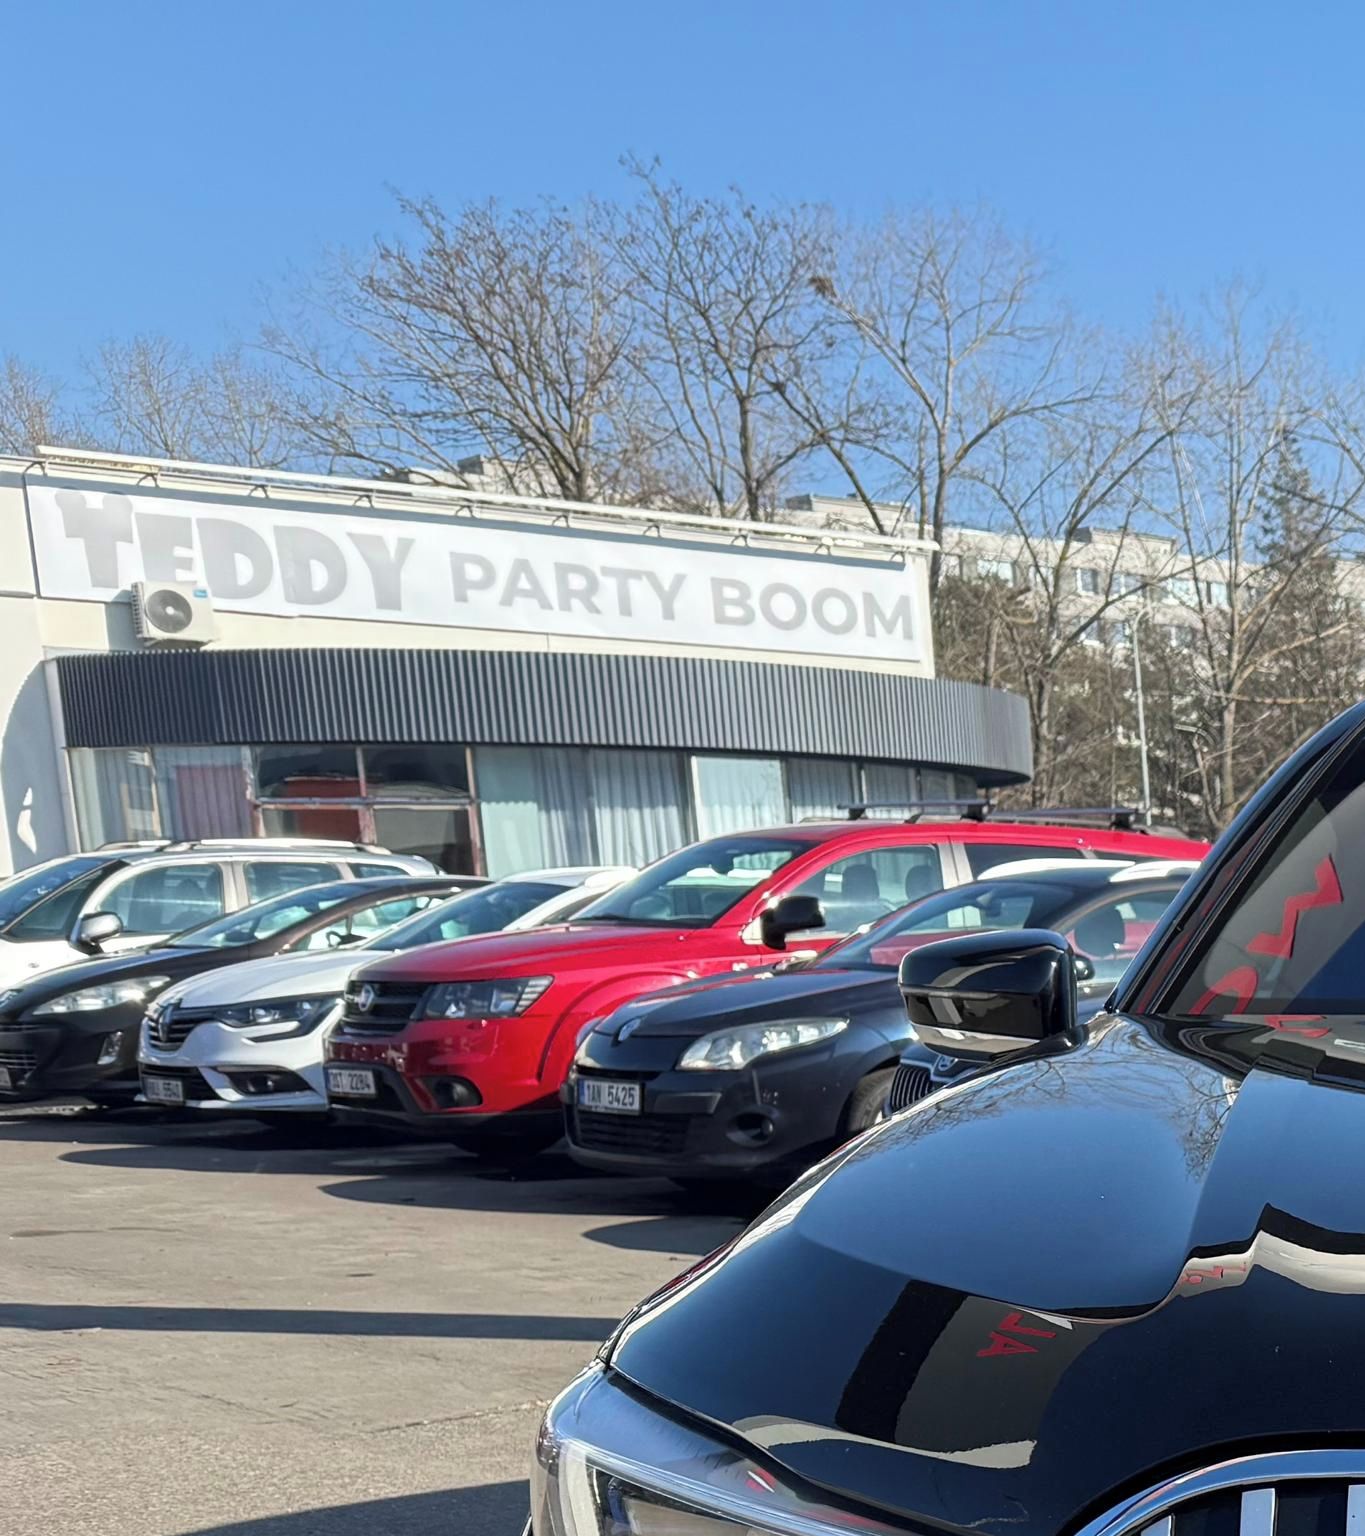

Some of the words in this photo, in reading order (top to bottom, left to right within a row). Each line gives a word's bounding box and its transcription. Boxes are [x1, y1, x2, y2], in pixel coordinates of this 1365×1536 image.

[55, 489, 415, 611] TEDDY
[449, 552, 686, 621] PARTY
[710, 577, 914, 641] BOOM
[587, 1084, 602, 1105] 1AN
[607, 1084, 635, 1108] 5425
